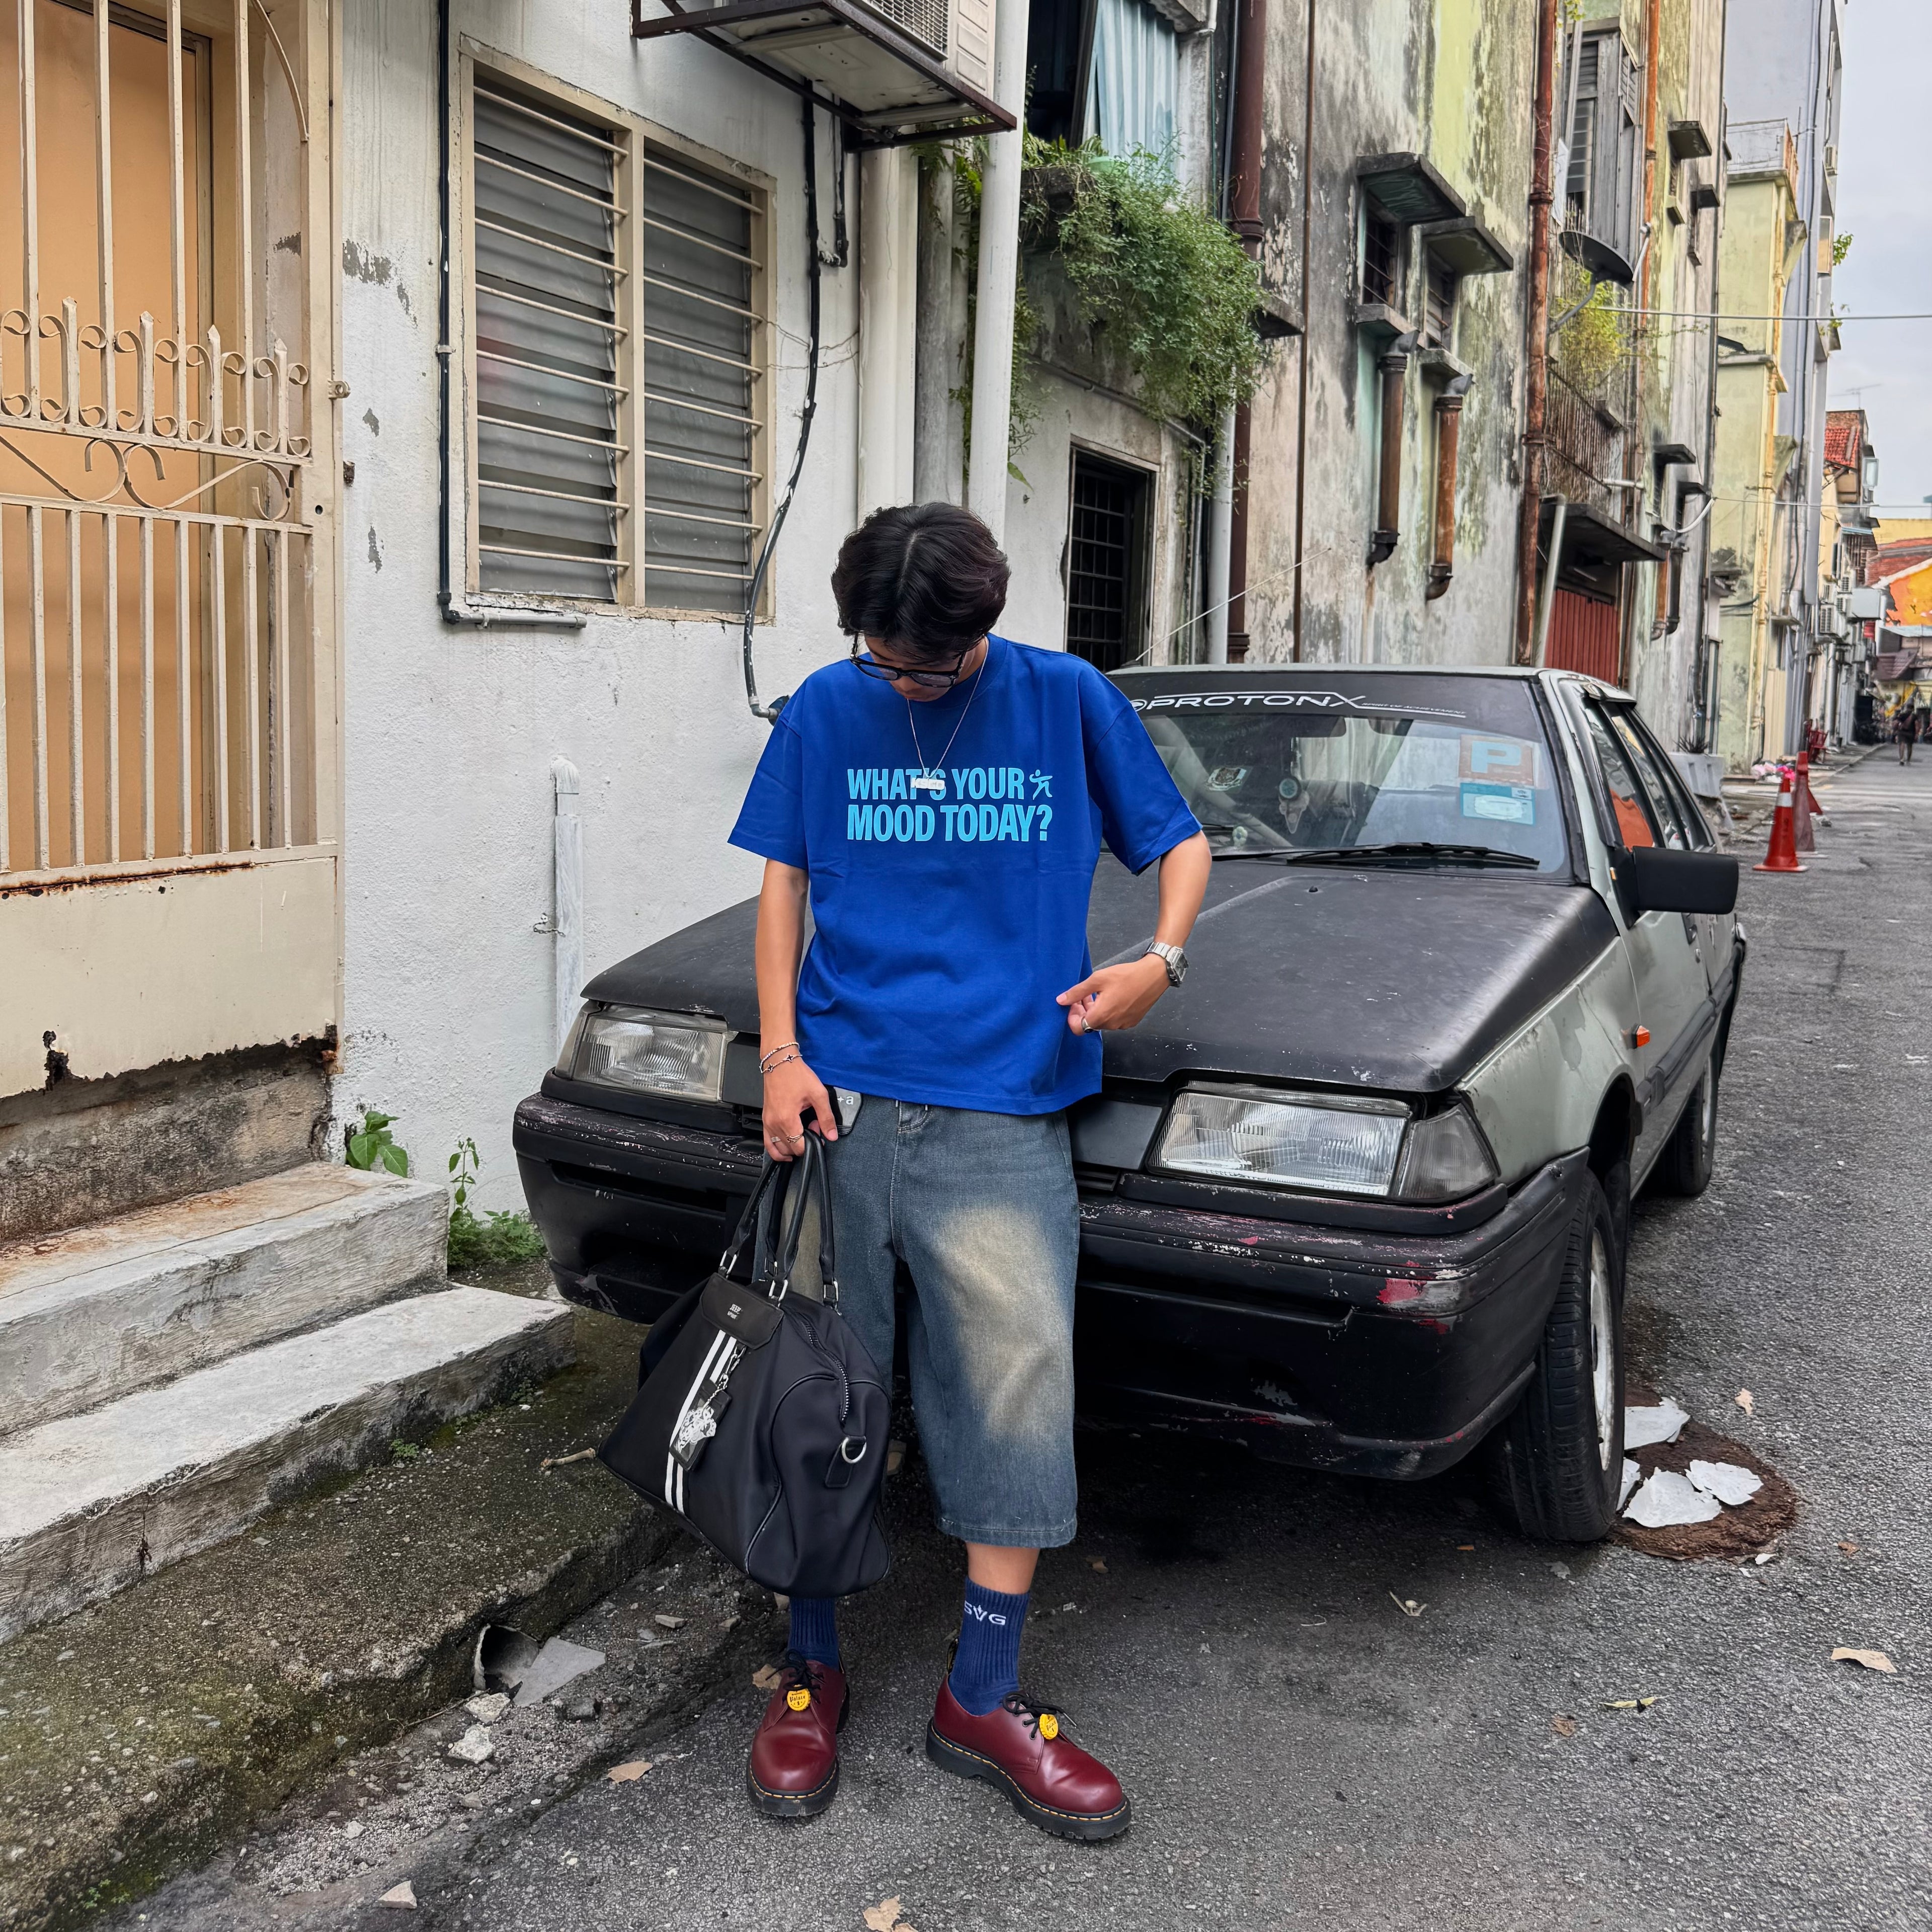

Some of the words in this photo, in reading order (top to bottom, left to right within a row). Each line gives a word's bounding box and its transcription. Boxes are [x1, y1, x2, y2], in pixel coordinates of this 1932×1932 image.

[1471, 740, 1522, 774] P
[847, 768, 946, 800] WHAT'S
[951, 767, 1024, 800] YOUR
[847, 804, 935, 842] MOOD
[940, 803, 1053, 842] TODAY?
